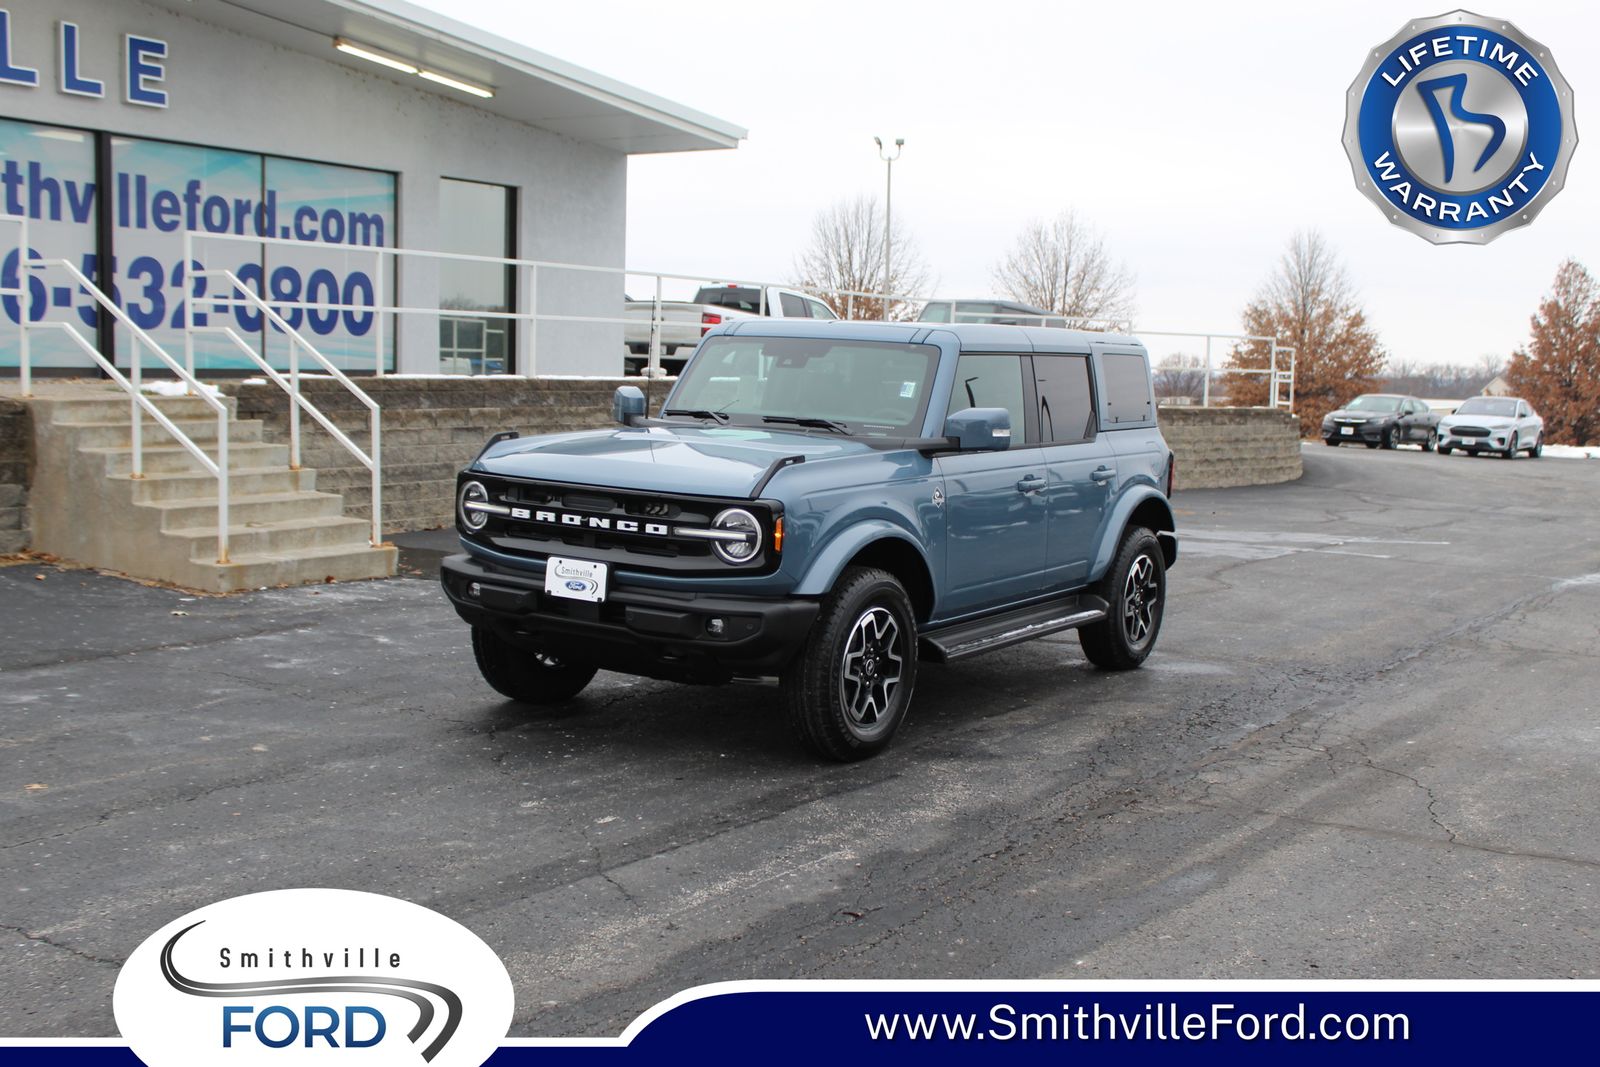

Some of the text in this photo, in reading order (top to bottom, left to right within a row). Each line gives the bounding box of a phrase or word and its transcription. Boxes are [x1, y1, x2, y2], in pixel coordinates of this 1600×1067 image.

[1, 160, 384, 247] thvlleford.com
[511, 507, 668, 535] BRONCO
[561, 566, 593, 578] Smithville
